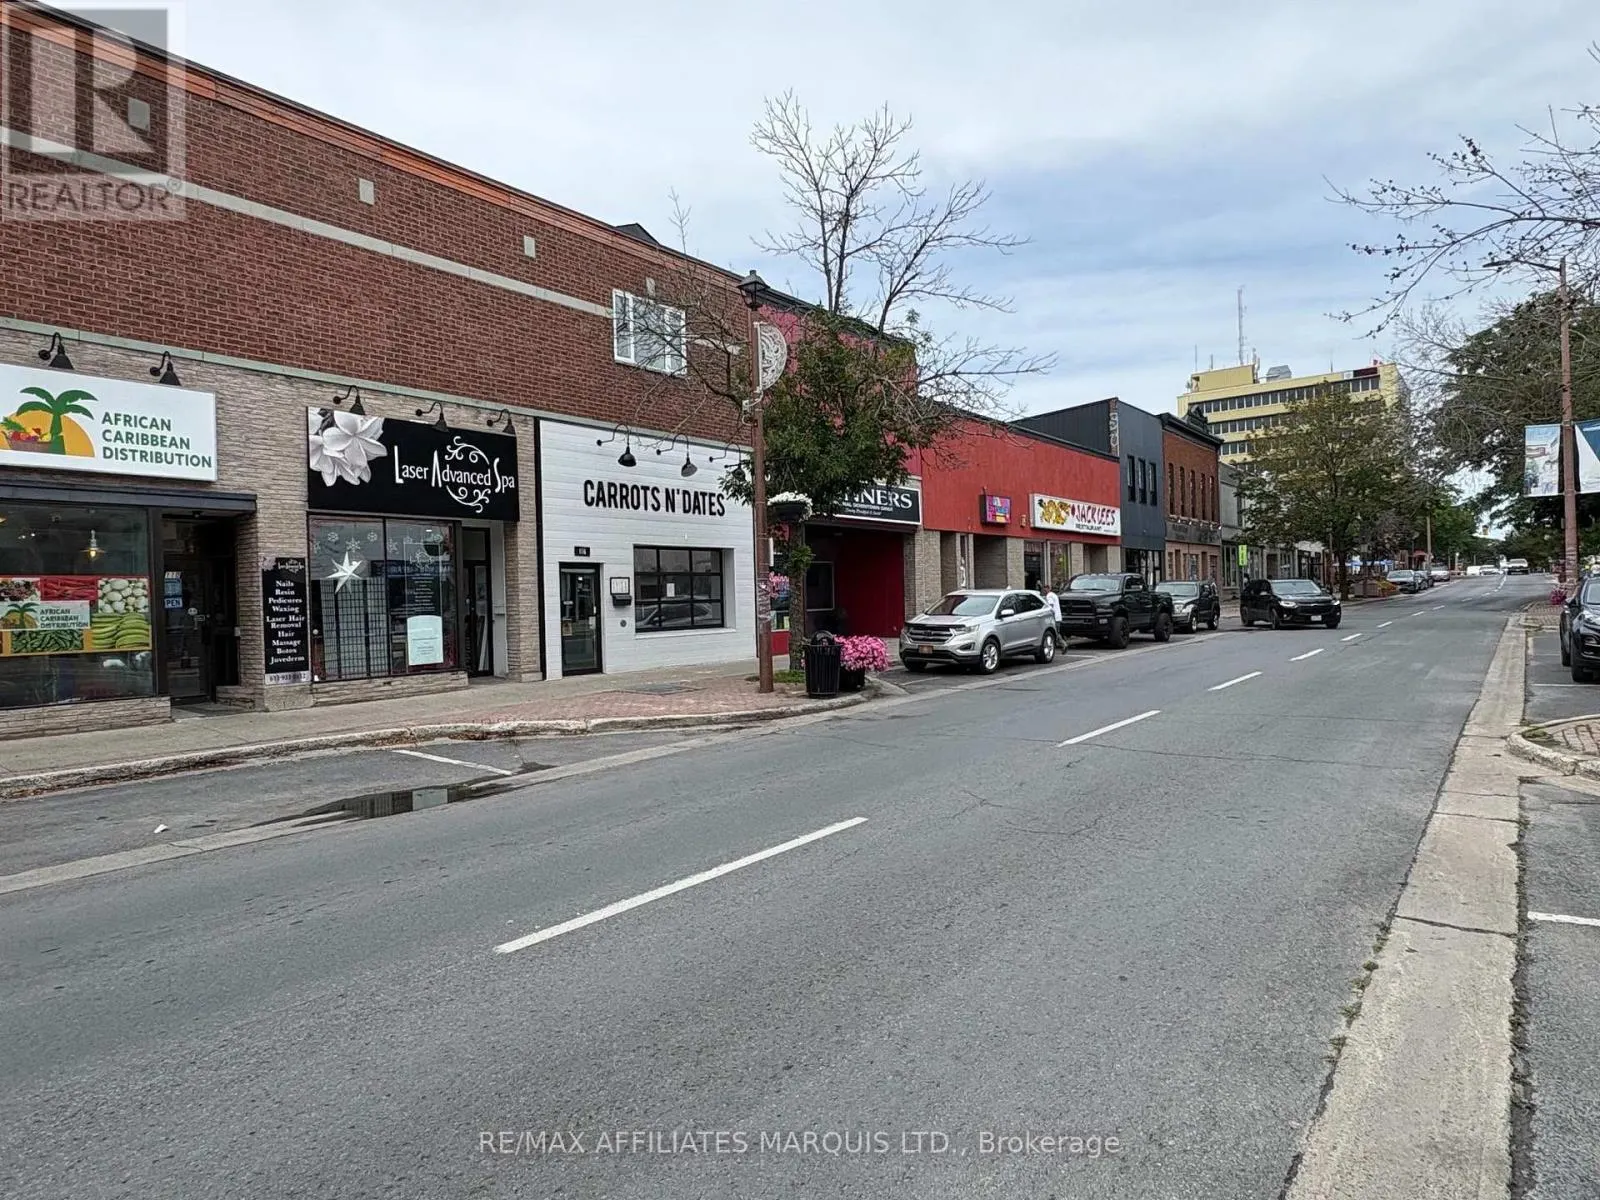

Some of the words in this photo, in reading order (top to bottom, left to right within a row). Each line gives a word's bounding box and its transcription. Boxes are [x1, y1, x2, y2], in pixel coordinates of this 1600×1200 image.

[101, 411, 172, 432] AFRICAN
[101, 428, 191, 451] CARIBBEAN
[102, 446, 213, 469] DISTRIBUTION
[394, 445, 429, 484] Laser
[431, 449, 492, 488] Advanced
[493, 457, 516, 494] Spa
[583, 479, 662, 513] CARROTS
[682, 489, 726, 517] DATES
[271, 605, 300, 613] Waxing
[289, 614, 305, 622] Hair
[40, 621, 89, 629] DISTRIBUTION
[277, 630, 296, 638] Hair
[272, 639, 302, 647] Massage
[269, 656, 305, 665] Juvederm
